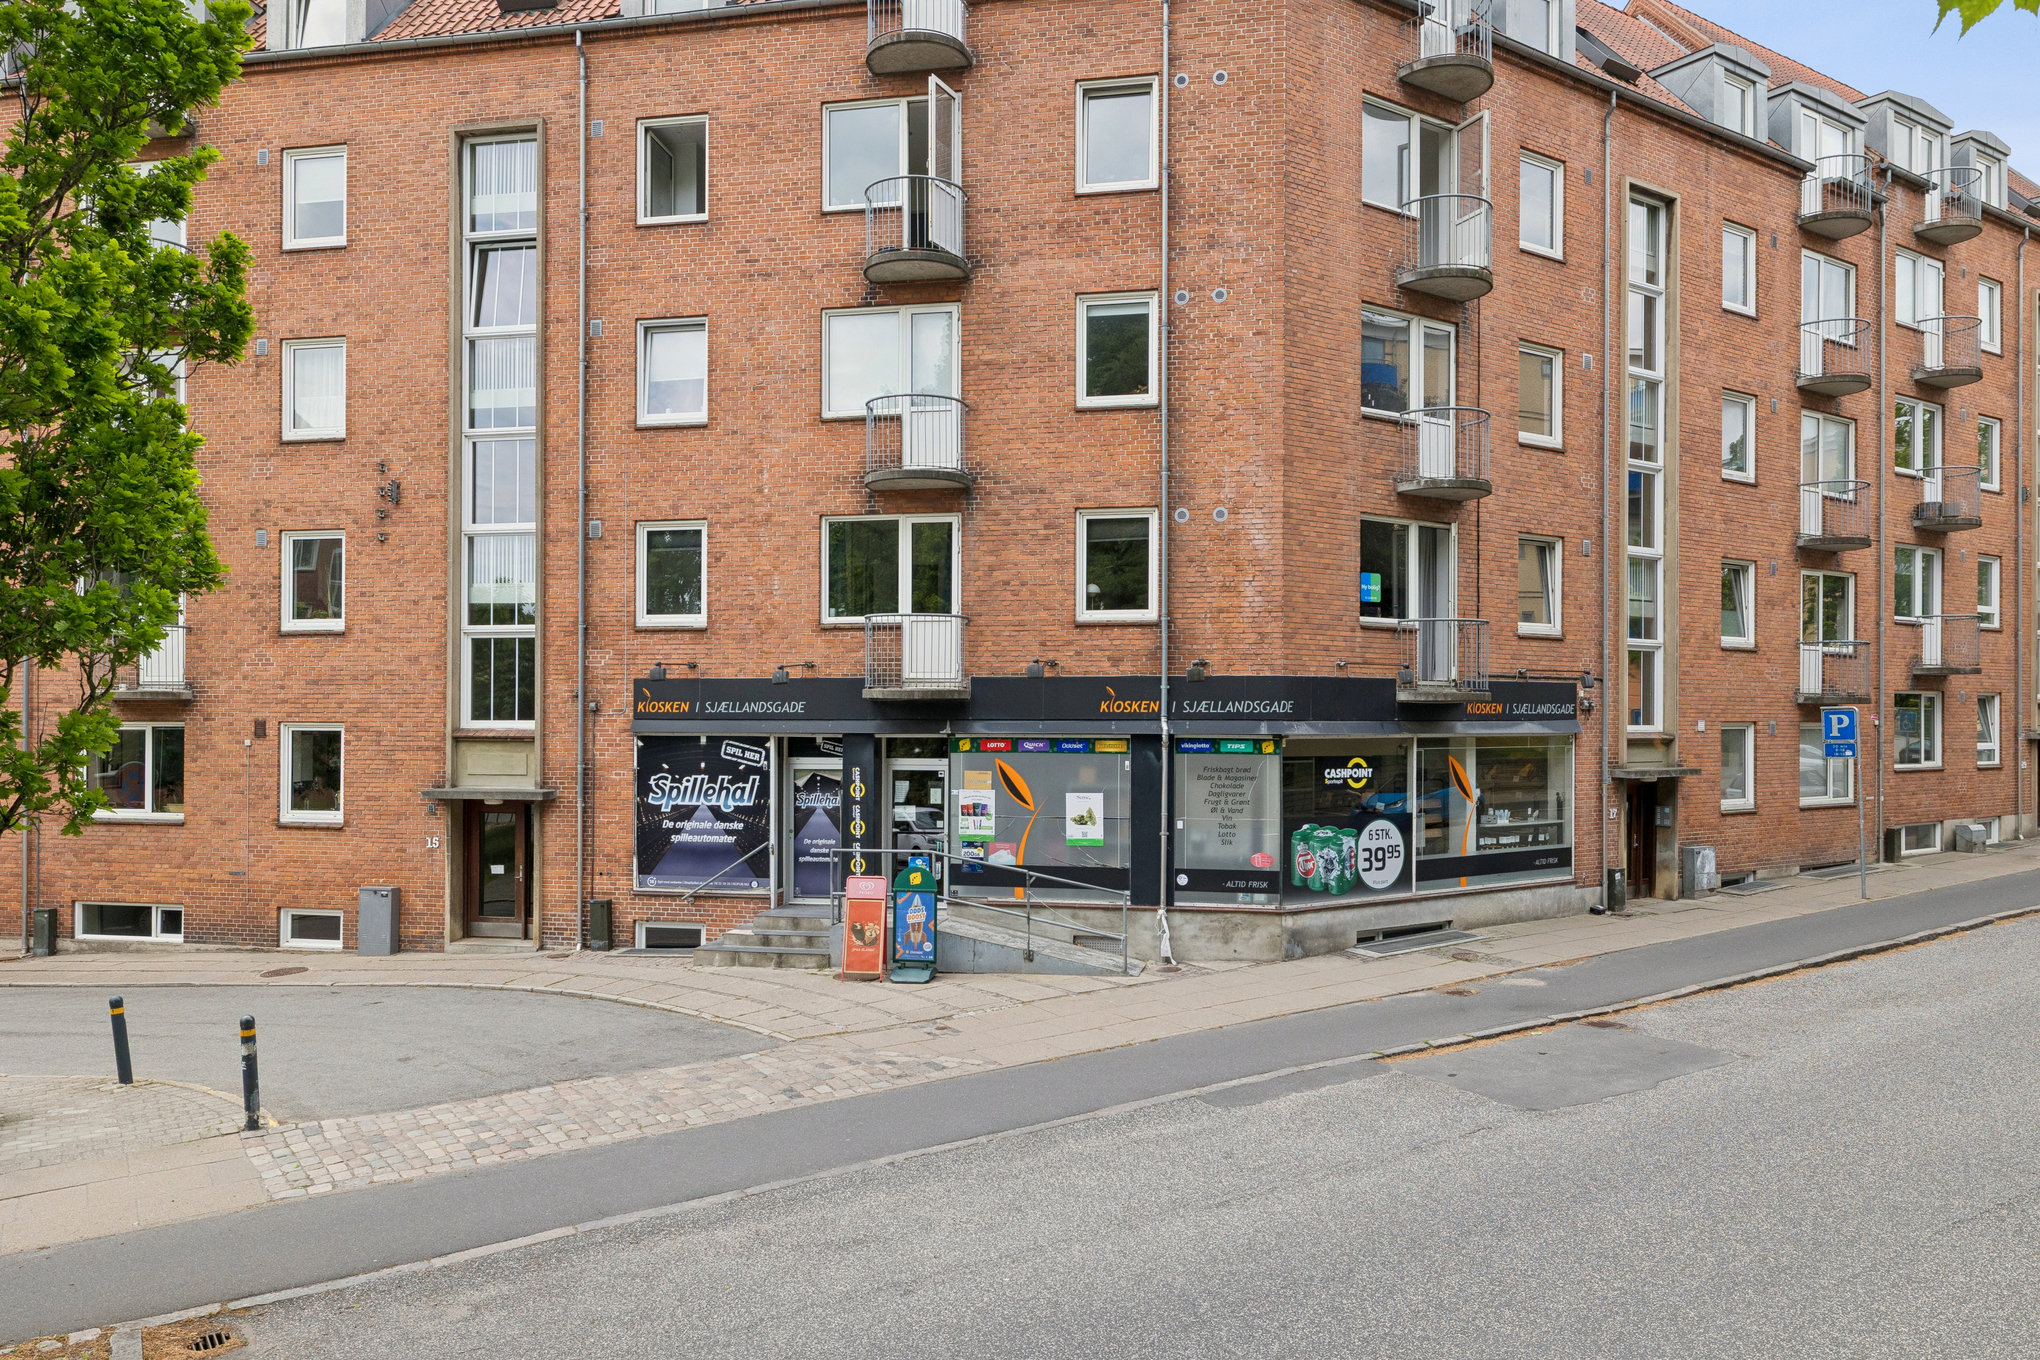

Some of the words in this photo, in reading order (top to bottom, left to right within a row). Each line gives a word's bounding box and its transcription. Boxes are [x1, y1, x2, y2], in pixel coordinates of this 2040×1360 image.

[637, 698, 690, 713] KIOSKEN
[705, 701, 806, 713] SJÆLLANDSGADE
[1100, 697, 1160, 713] KIOSKEN
[1183, 700, 1294, 713] SJÆLLANDSGADE
[1466, 702, 1503, 714] KIOSKEN
[1512, 703, 1576, 715] SJÆLLANDSGADE
[1829, 714, 1850, 737] P
[726, 745, 743, 757] SPIL
[744, 750, 760, 761] HER
[823, 743, 834, 751] SPIL
[1203, 766, 1234, 774] Friskbagt
[1324, 768, 1373, 778] CASHPOINT
[648, 773, 760, 813] Spillehal
[1208, 790, 1246, 798] Dagligvarer
[1203, 798, 1222, 806] Frugt
[662, 819, 674, 829] De
[675, 820, 713, 831] originale
[713, 820, 744, 830] danske
[670, 833, 737, 845] spilleautomater
[1368, 829, 1374, 841] 6
[1375, 828, 1393, 840] STK.
[426, 837, 440, 849] 15
[1248, 881, 1269, 889] FRISK
